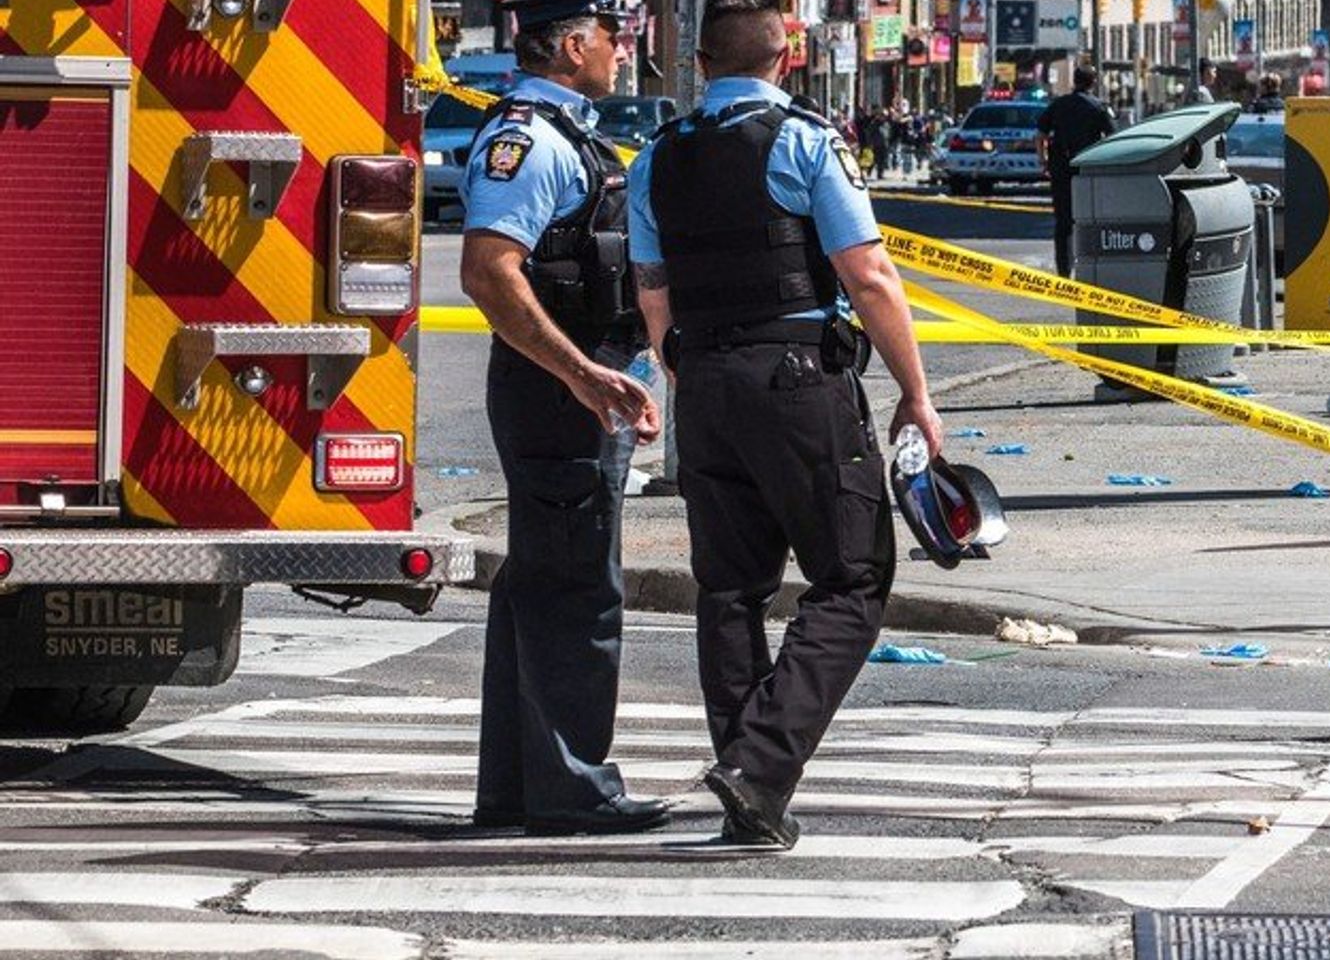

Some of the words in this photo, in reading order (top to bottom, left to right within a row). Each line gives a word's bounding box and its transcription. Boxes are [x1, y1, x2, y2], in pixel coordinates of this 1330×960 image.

[1101, 229, 1135, 251] Litter
[920, 245, 935, 257] DO
[937, 248, 959, 263] NOT
[959, 254, 994, 273] CROSS
[1009, 268, 1051, 290] POLICE
[1089, 290, 1104, 302] DO
[1106, 294, 1126, 307] NOT
[1127, 300, 1163, 316] CROSS
[44, 590, 184, 625] smeal
[46, 637, 143, 659] SNYDER,
[151, 637, 185, 656] NE.
